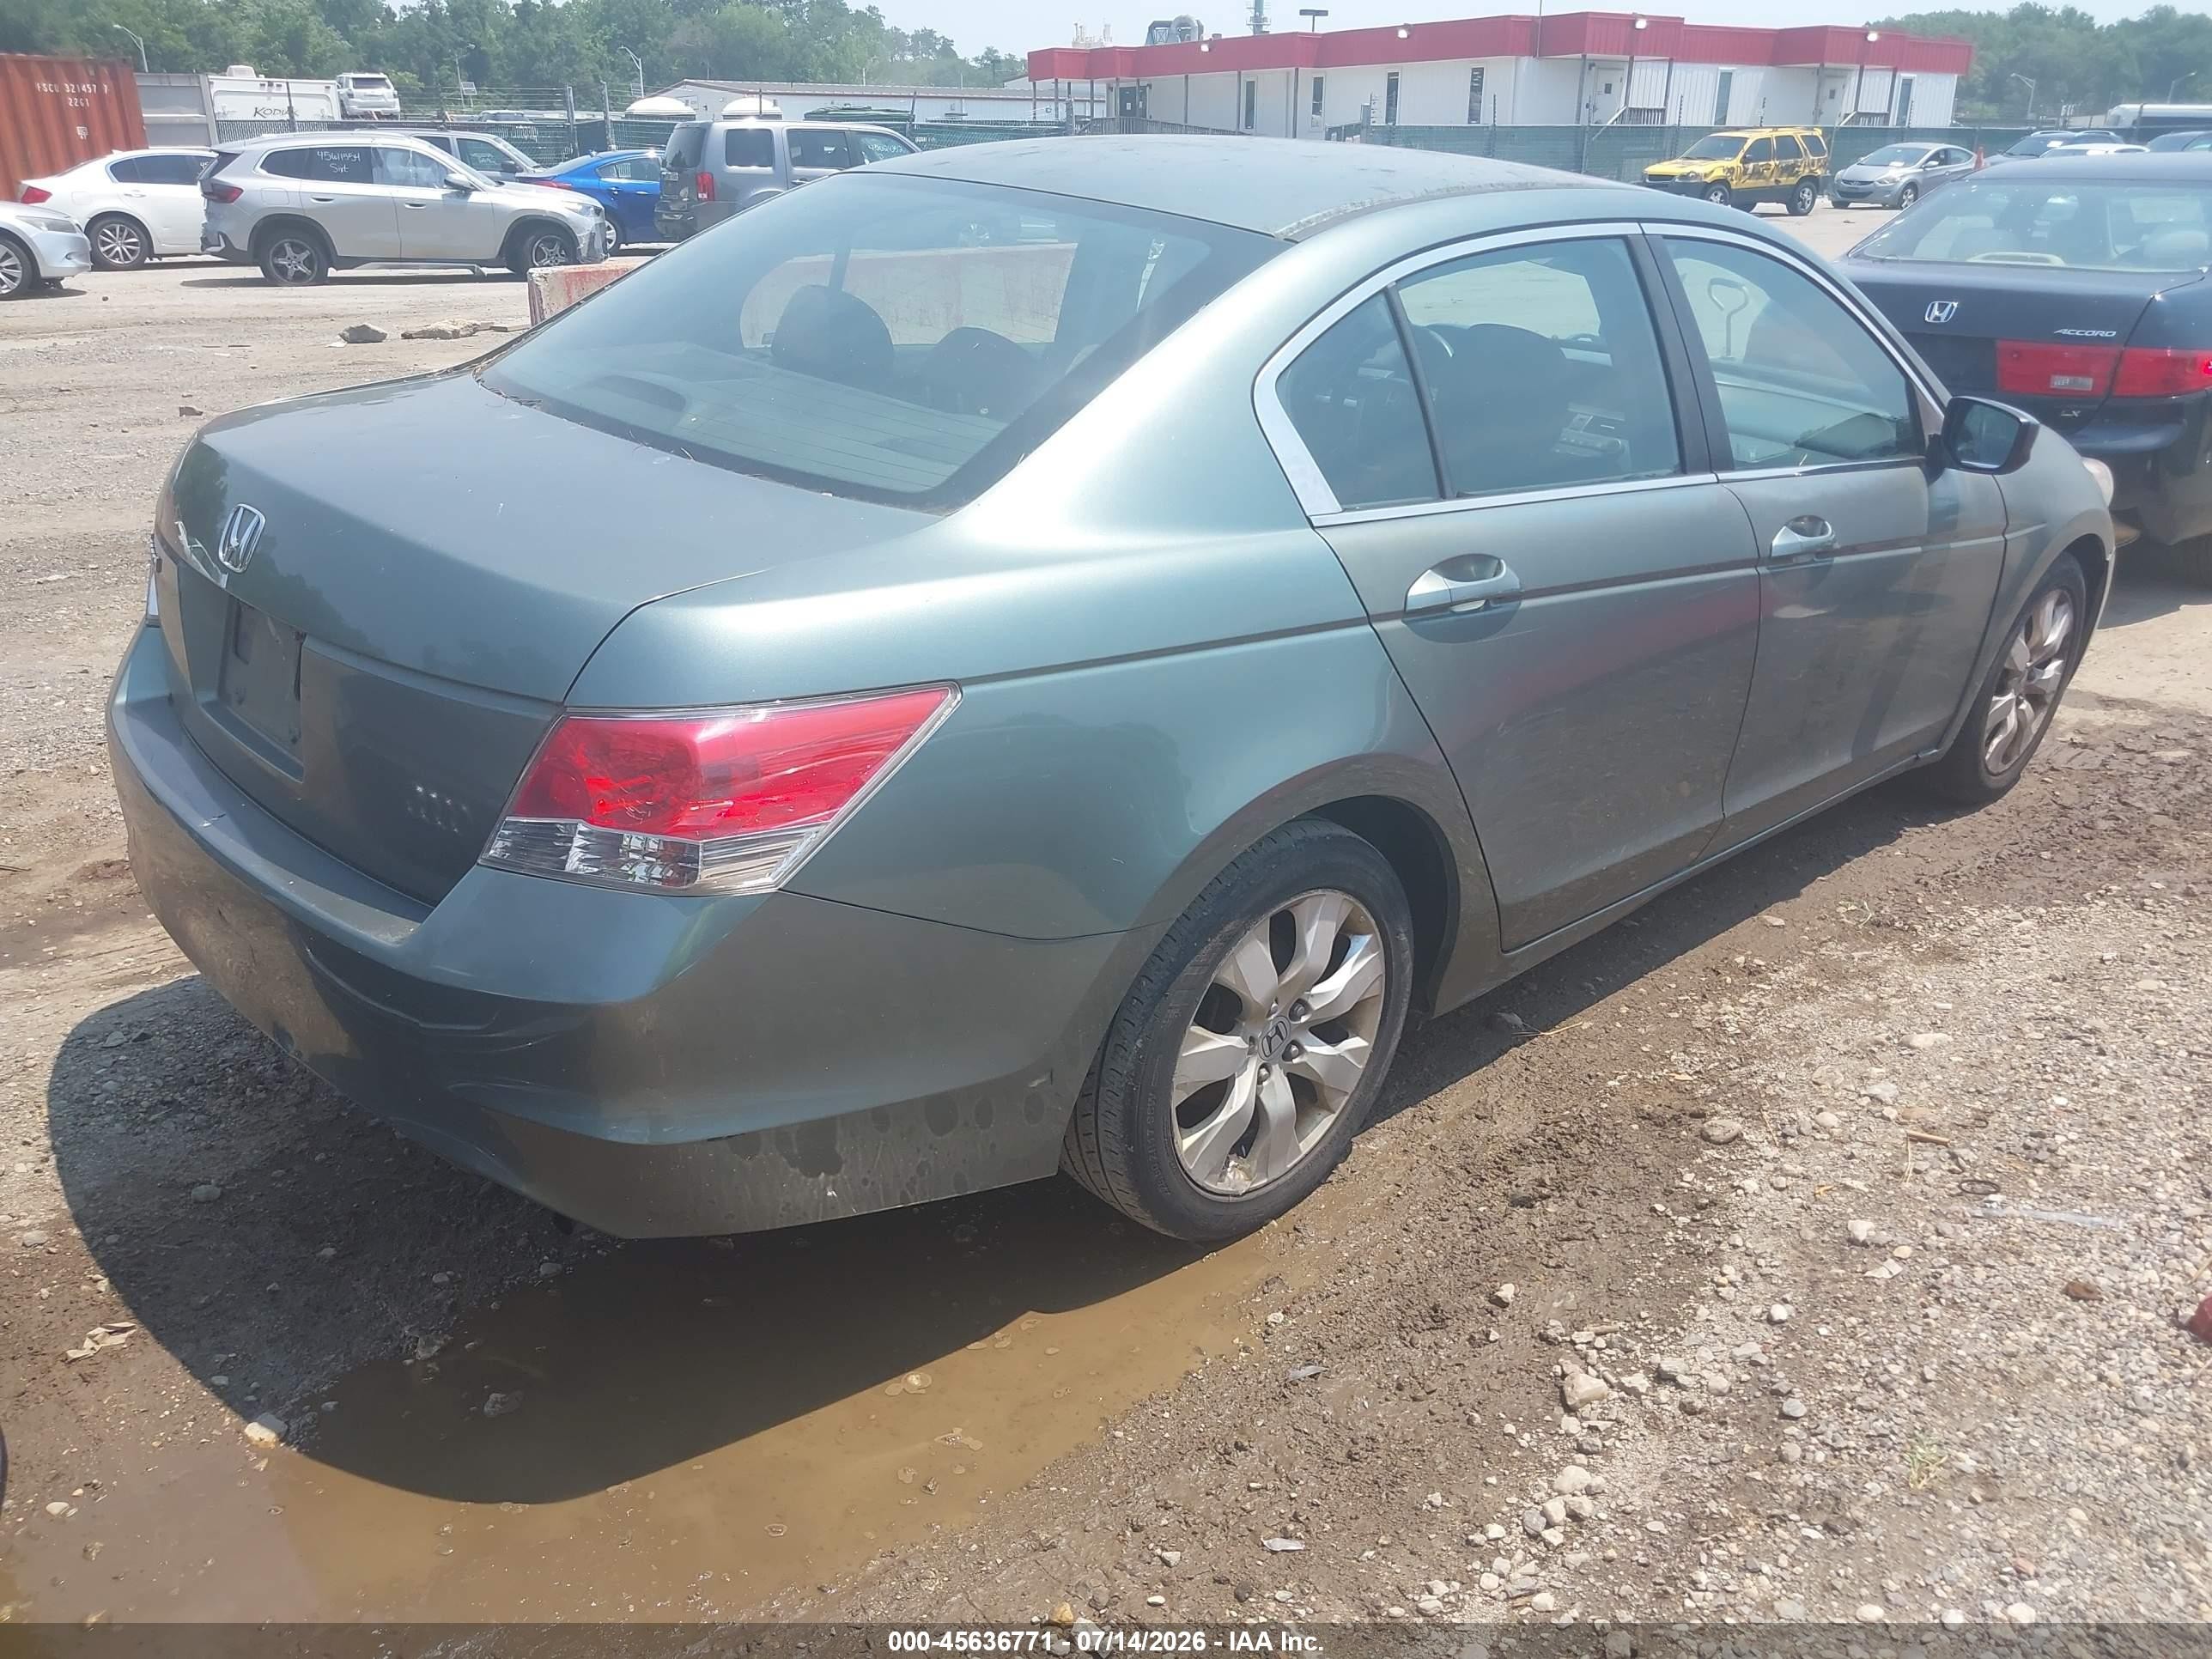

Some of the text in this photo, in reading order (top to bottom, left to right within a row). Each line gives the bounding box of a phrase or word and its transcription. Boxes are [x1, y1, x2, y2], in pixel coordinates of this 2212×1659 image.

[64, 82, 97, 94] 321457
[102, 83, 107, 94] 7
[2054, 328, 2117, 337] ACCORD
